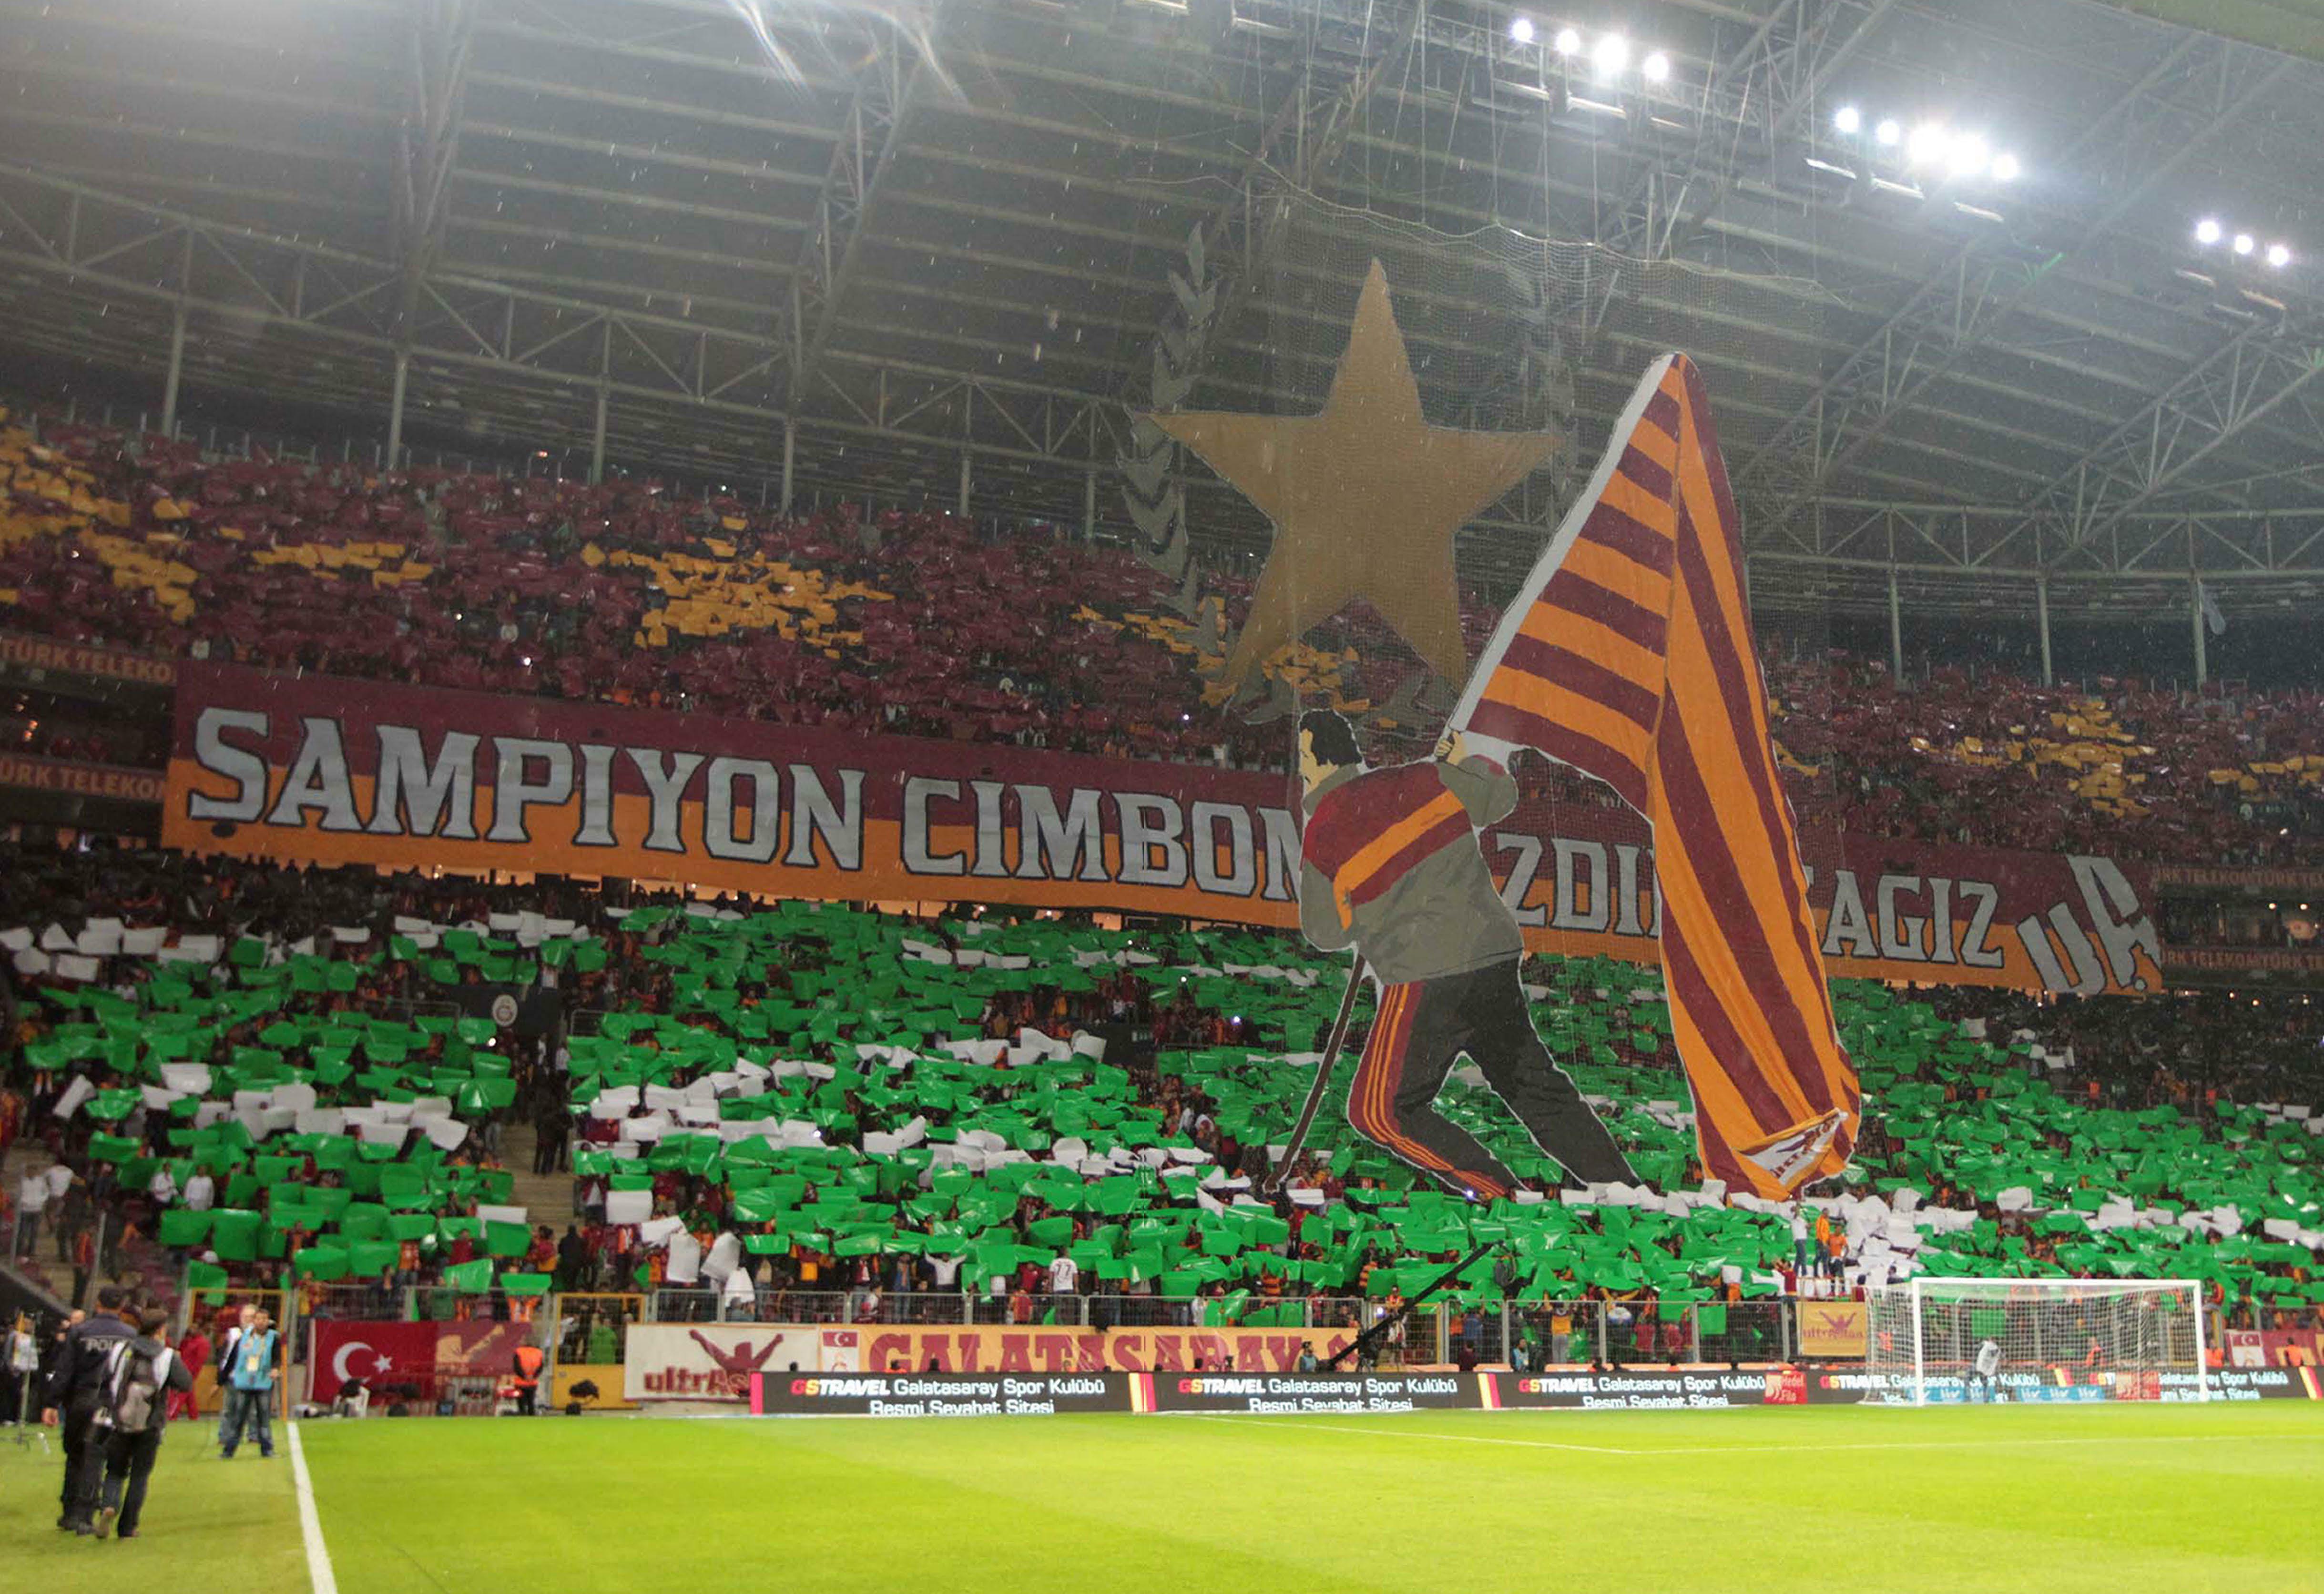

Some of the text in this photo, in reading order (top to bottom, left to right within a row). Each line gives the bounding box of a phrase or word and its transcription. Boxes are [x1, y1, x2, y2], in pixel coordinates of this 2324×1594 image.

[0, 758, 50, 789] ÜRK
[869, 1334, 1302, 1372] GALATASARAY
[894, 1379, 999, 1398] Galatasaray
[1003, 1378, 1045, 1397] Spor
[1050, 1378, 1105, 1394] Kulübü
[1268, 1378, 1362, 1396] Galatasaray
[1366, 1378, 1403, 1396] Spor
[1406, 1378, 1458, 1393] Kulübü
[1599, 1376, 1682, 1393] Galatasaray
[1684, 1376, 1717, 1392] Spor
[1720, 1375, 1766, 1390] Kulübü
[870, 1400, 925, 1415] Resmi
[1005, 1399, 1055, 1414] Sitesi
[1249, 1398, 1297, 1412] Resmi
